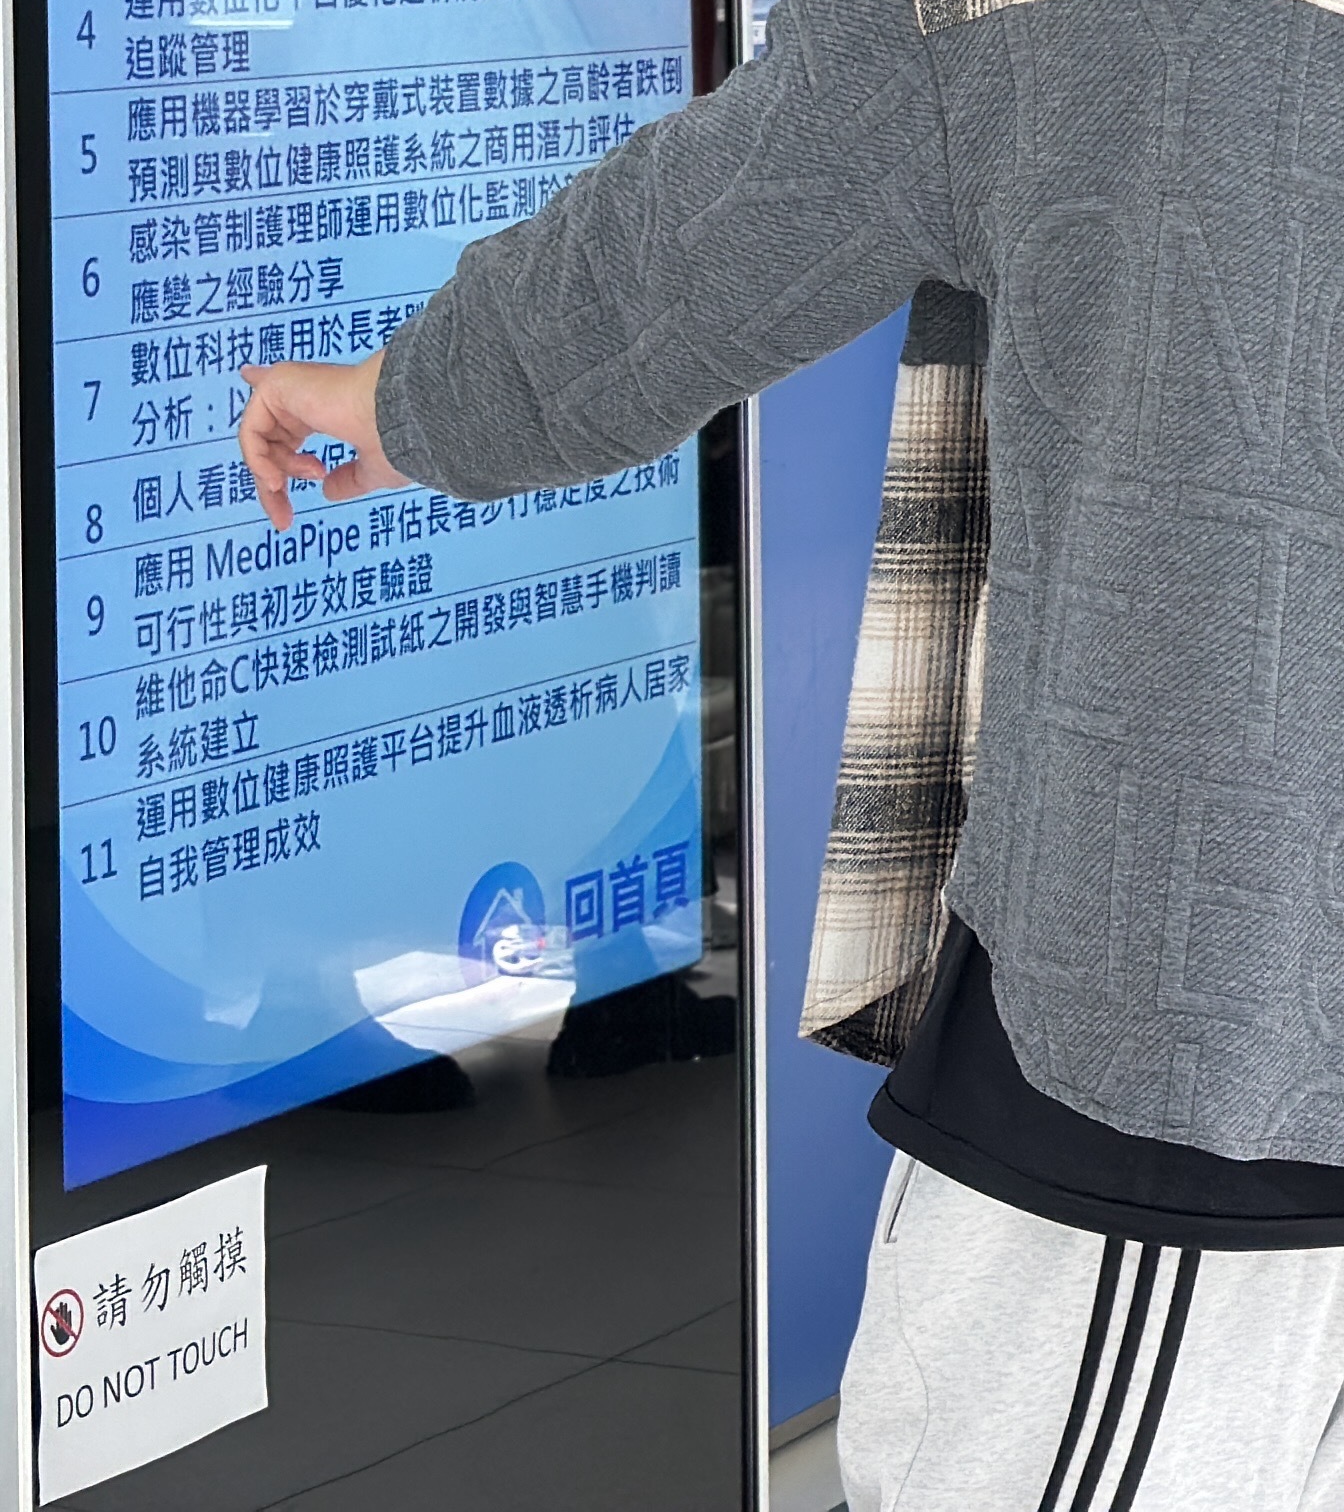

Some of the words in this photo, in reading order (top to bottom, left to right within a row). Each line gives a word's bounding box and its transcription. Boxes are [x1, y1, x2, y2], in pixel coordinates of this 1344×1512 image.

[76, 9, 96, 50] 4
[125, 30, 250, 81] 追蹤管理
[81, 134, 98, 175] 5
[82, 256, 100, 297] 6
[130, 256, 344, 325] 應變之經驗分享
[83, 380, 101, 422] 7
[85, 503, 104, 545] 8
[87, 594, 105, 637] 9
[134, 544, 194, 599] 應用
[206, 520, 360, 581] MediaPipe
[134, 552, 434, 657] 可行性與初步效度驗證
[79, 715, 117, 762] 10
[80, 838, 118, 885] 11
[136, 654, 690, 843] 運用數位健康照護平台提升血液透析病人居家
[136, 709, 260, 779] 系統建立
[139, 809, 321, 902] 自我管理成效
[565, 841, 690, 948] 回首頁
[93, 1226, 247, 1330] 請勿觸摸
[57, 1384, 94, 1428] DO
[103, 1356, 160, 1408] NOT
[167, 1317, 248, 1381] TOUCH
